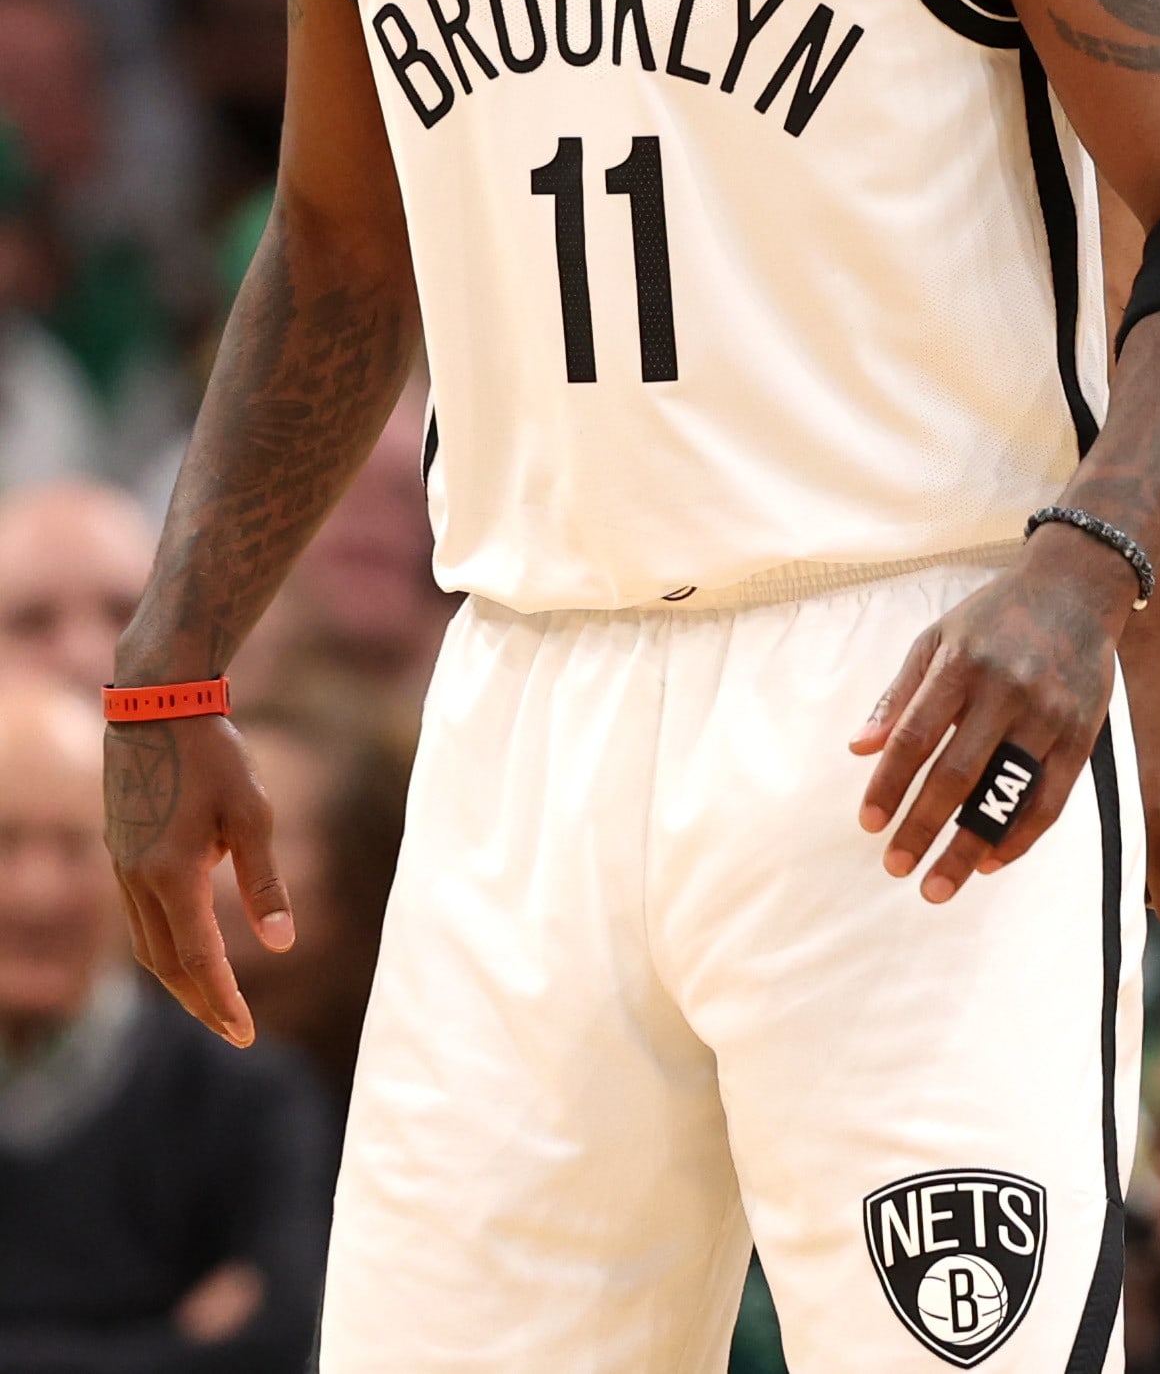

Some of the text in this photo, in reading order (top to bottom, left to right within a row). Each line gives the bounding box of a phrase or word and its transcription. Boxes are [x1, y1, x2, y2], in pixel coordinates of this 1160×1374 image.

[530, 135, 679, 384] 11
[978, 759, 1033, 825] KAI
[880, 1182, 1035, 1268] NETS
[949, 1268, 979, 1334] B
